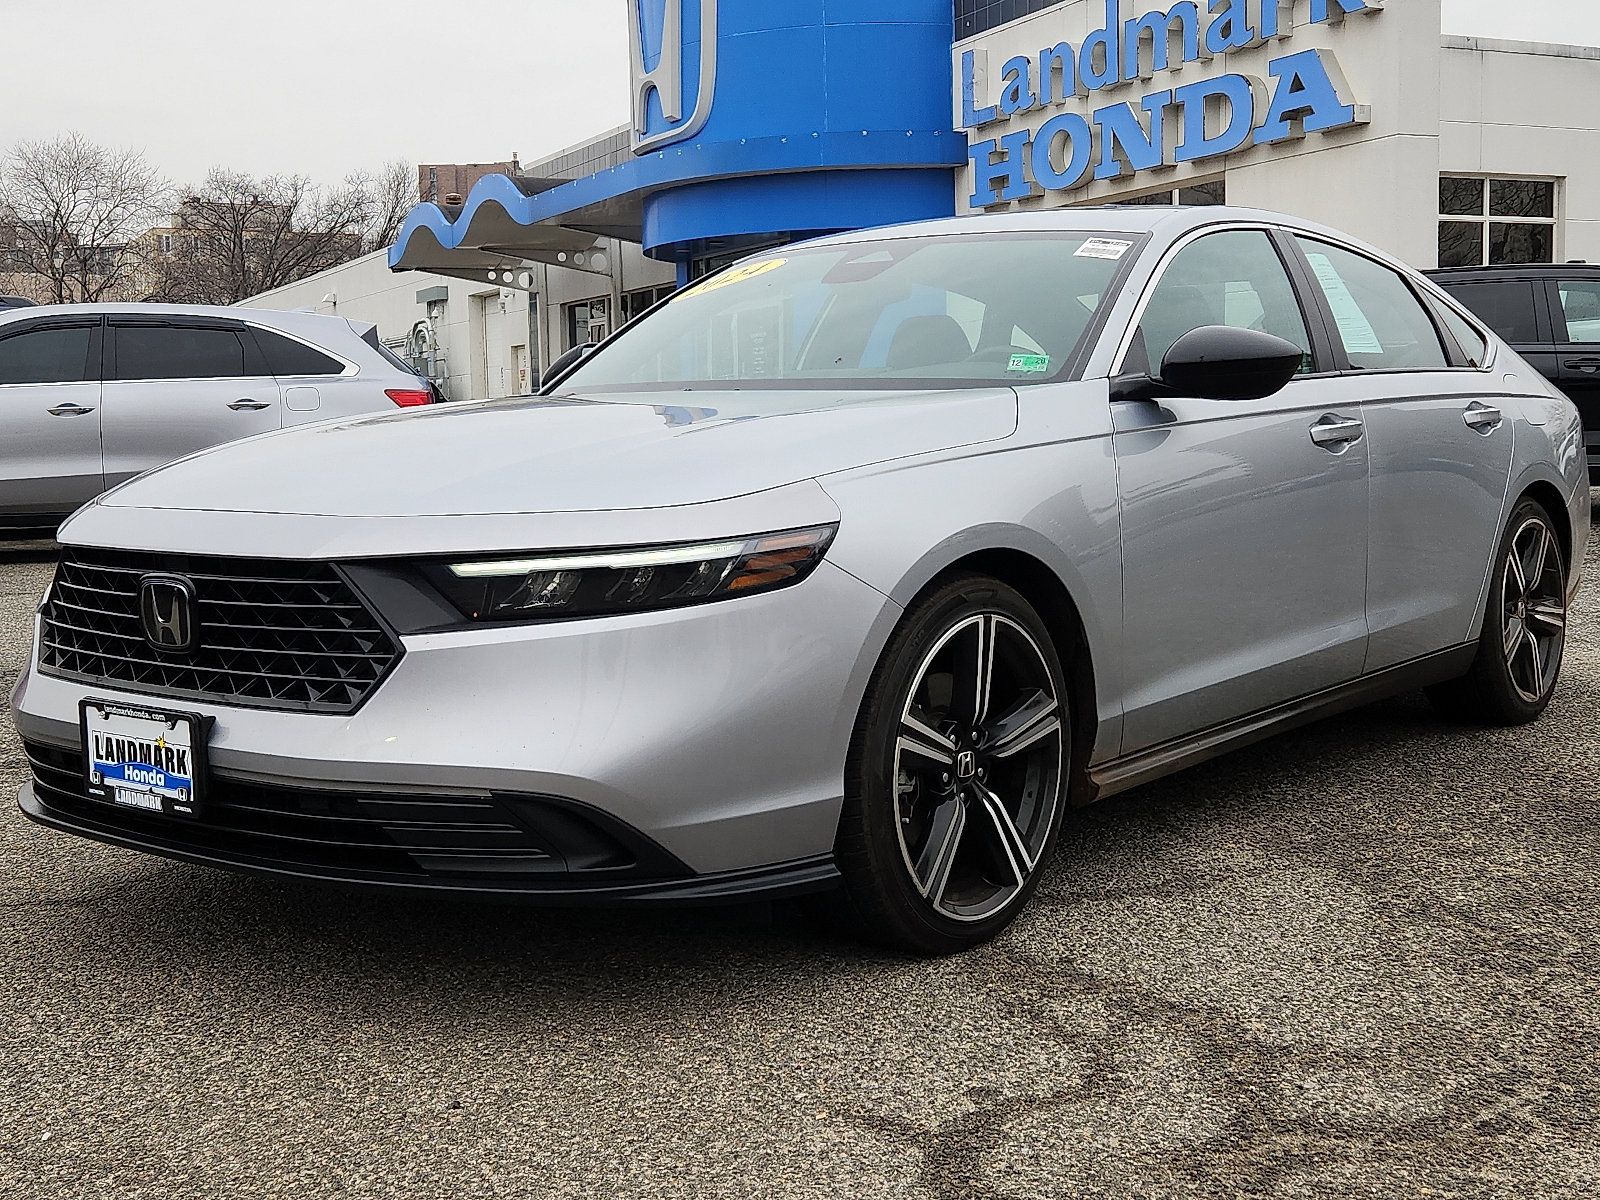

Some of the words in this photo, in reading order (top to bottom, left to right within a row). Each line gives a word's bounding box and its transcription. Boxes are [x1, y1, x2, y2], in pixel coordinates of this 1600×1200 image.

[961, 0, 1368, 129] Landmar
[968, 48, 1355, 209] HONDA
[1011, 359, 1022, 367] 12
[94, 734, 188, 776] LANDMARK
[124, 764, 165, 787] Honda
[115, 788, 163, 811] LANDMARK
